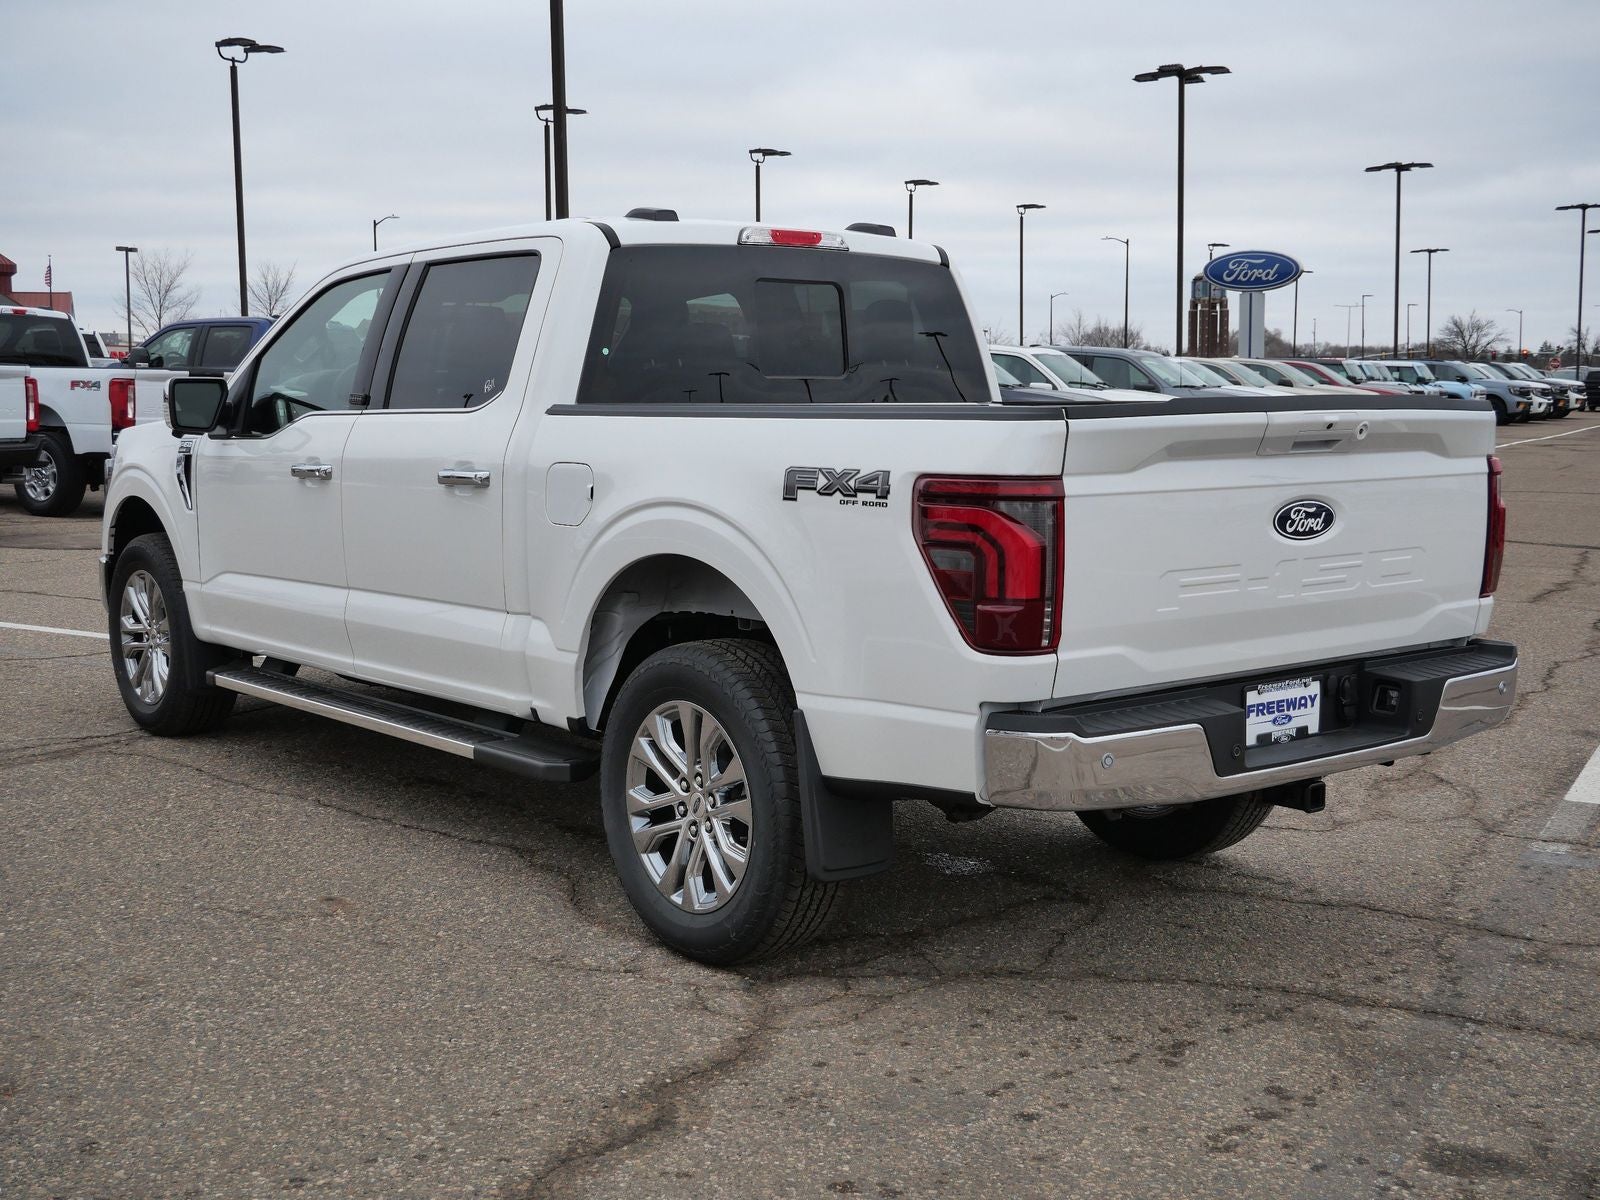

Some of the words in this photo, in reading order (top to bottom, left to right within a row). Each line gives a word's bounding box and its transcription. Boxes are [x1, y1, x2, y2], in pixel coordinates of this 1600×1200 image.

[1222, 258, 1280, 282] Ford
[70, 380, 101, 390] FX4
[782, 466, 891, 501] FX4
[861, 500, 888, 508] ROAD
[1286, 506, 1326, 533] Ford
[1157, 546, 1427, 612] F-150
[1257, 677, 1313, 691] FreewayFord.net
[1246, 693, 1318, 719] FREEWAY
